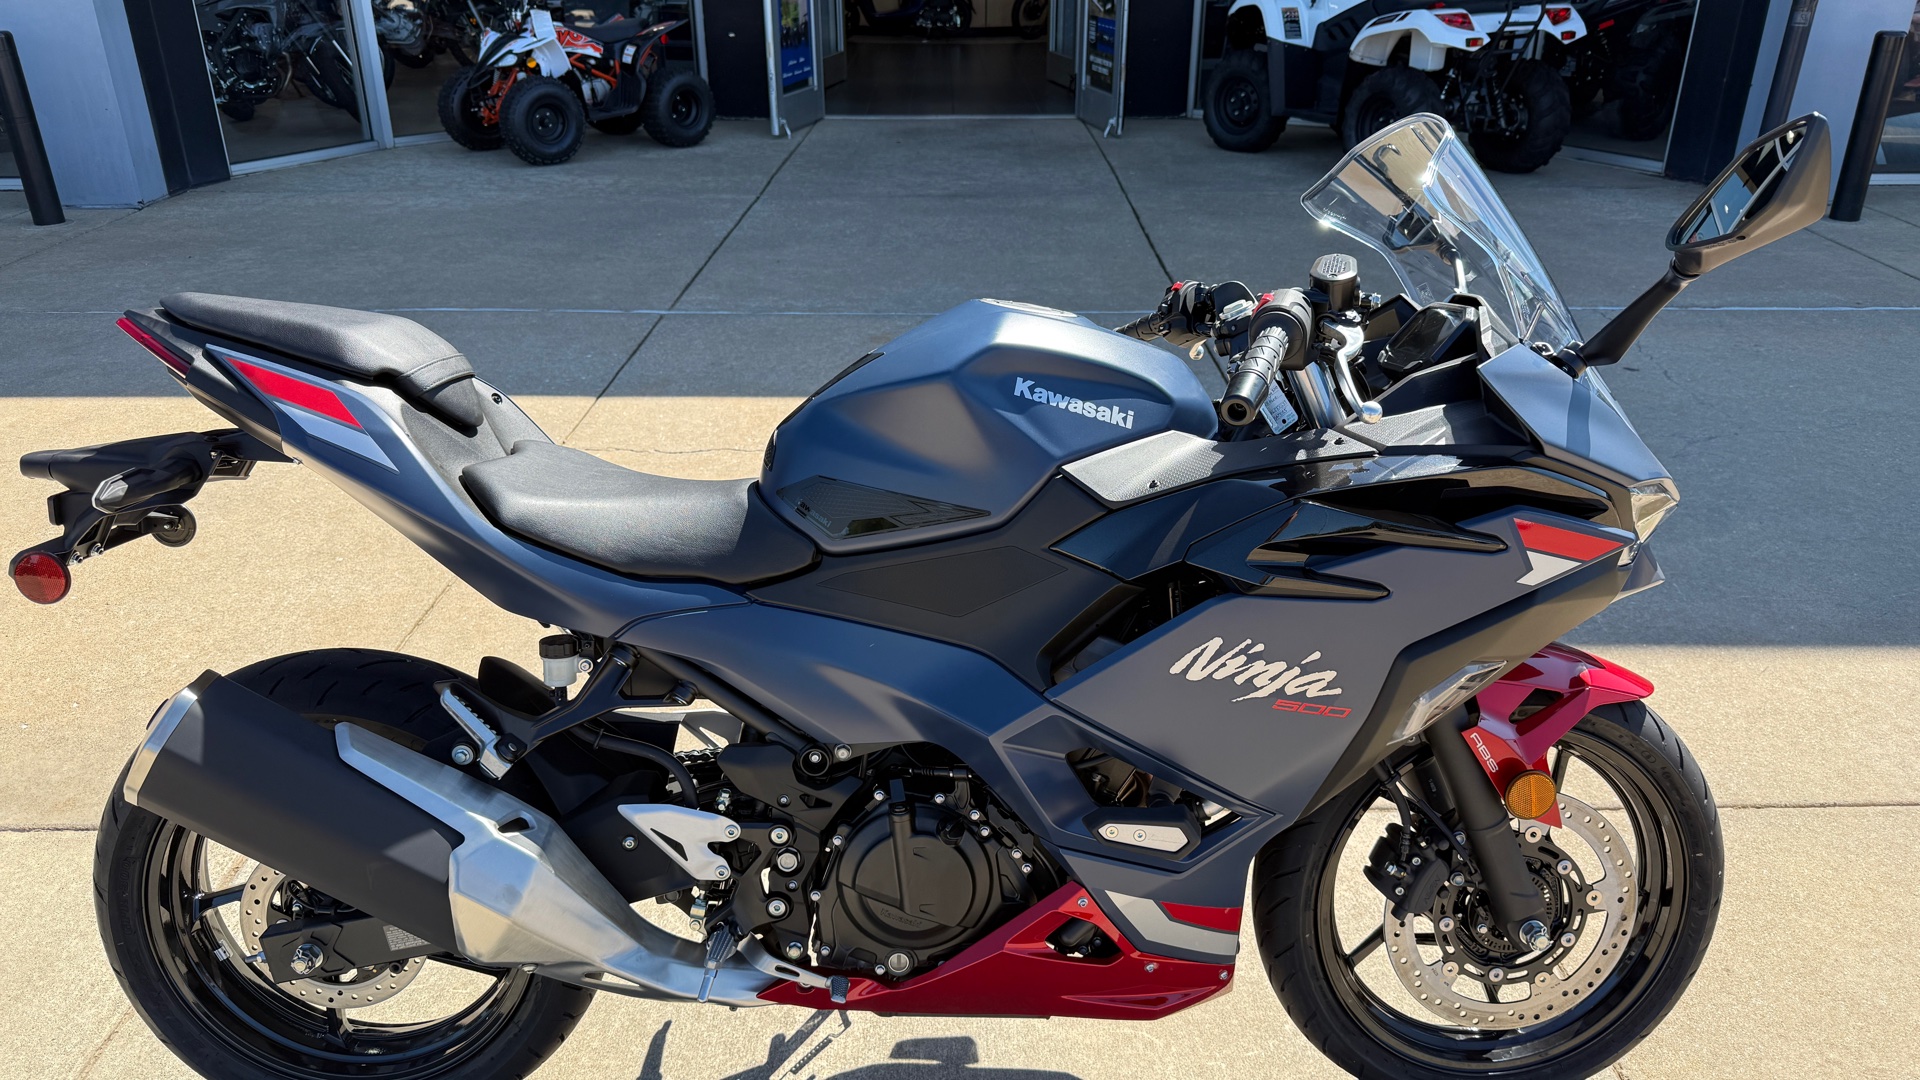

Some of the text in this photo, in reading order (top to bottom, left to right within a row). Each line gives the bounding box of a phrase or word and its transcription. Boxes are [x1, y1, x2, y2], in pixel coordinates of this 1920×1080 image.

[1013, 376, 1135, 429] Kawasaki
[1169, 636, 1342, 702] Ninja
[1271, 699, 1352, 718] 500
[1470, 732, 1499, 773] ABS
